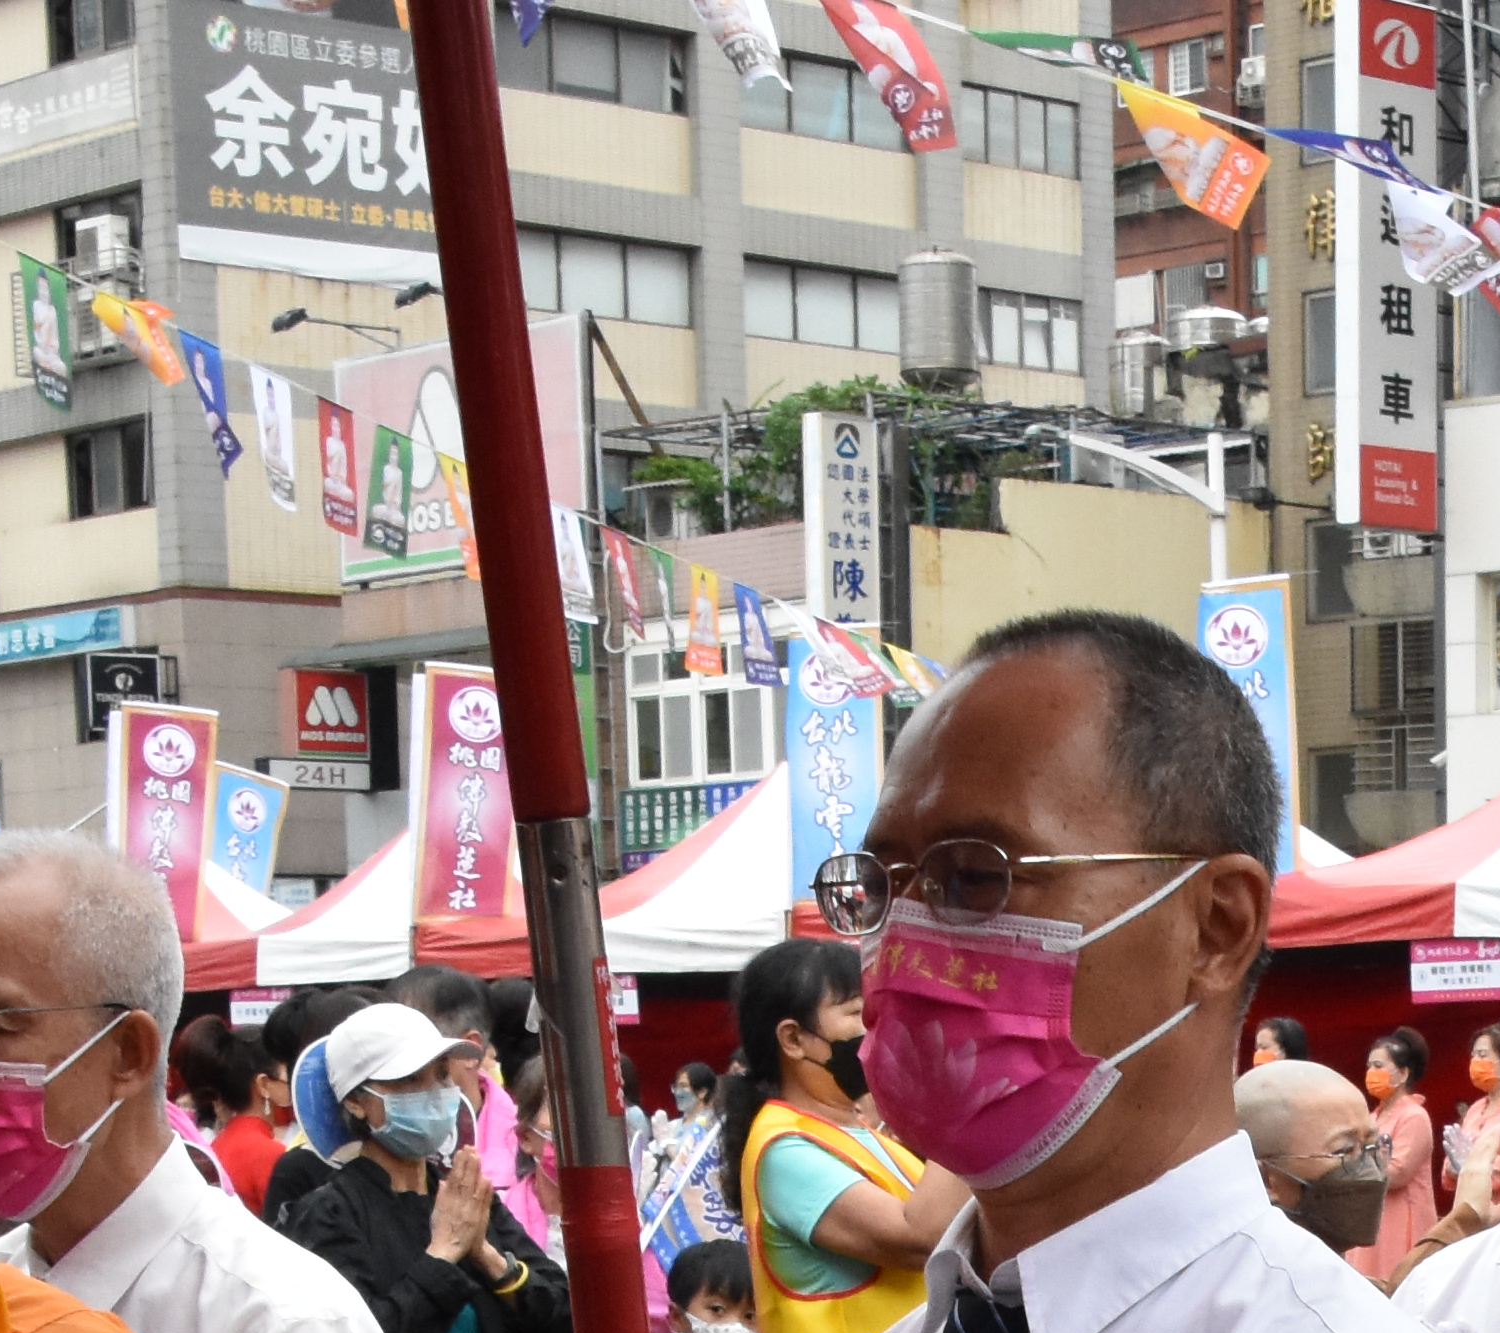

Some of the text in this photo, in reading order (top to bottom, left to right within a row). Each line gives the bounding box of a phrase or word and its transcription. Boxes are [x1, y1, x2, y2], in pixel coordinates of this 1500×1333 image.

[832, 558, 868, 624] 陳
[300, 731, 365, 742] MOS BURGER
[143, 776, 192, 804] 桃園
[295, 765, 346, 785] 24H
[448, 743, 501, 911] 桃園 佛教蓮社
[810, 746, 855, 857] 龍雲
[871, 940, 999, 992] 佛教蓮社
